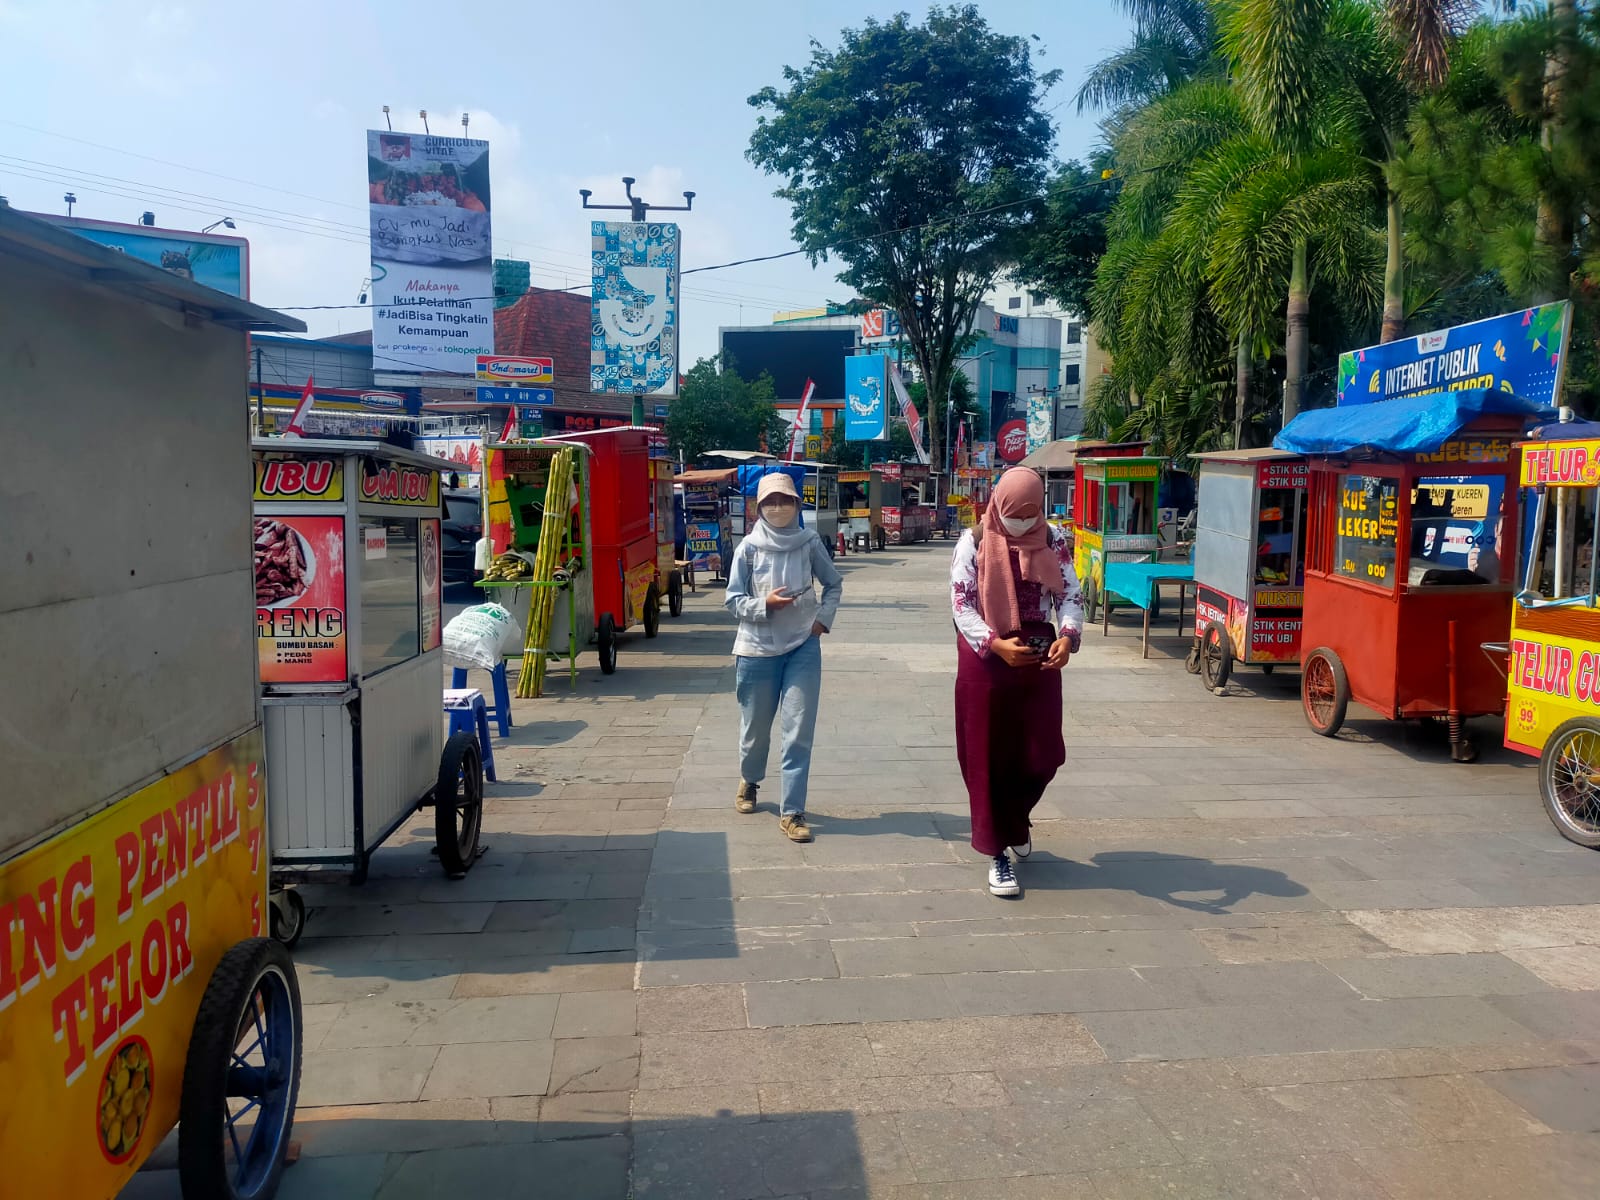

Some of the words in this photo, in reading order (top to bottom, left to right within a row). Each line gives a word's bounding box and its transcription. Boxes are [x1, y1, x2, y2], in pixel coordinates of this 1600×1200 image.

[405, 279, 460, 294] Makanya
[393, 295, 416, 306] Ikut
[419, 297, 472, 309] Pelatihan
[377, 309, 433, 321] #JadiBisa
[436, 312, 488, 325] Tingkatin
[399, 325, 469, 338] Kemampuan
[444, 345, 490, 355] tokopedia
[491, 362, 538, 374] Indomaret
[1385, 357, 1435, 395] INTERNET
[1437, 343, 1482, 382] PUBLIK
[565, 416, 595, 428] POS
[1107, 466, 1128, 477] TELUR
[1130, 465, 1157, 477] GULUNG
[1270, 465, 1289, 474] STIK
[1293, 465, 1310, 474] KEN
[1526, 448, 1587, 482] TELUR
[262, 459, 333, 495] IBU
[1269, 477, 1288, 486] STIK
[1292, 477, 1307, 486] UBI
[401, 470, 429, 501] IBU
[1343, 489, 1367, 511] KUE
[1457, 489, 1483, 499] KUEREN
[1338, 517, 1378, 539] LEKER
[691, 540, 717, 552] LEKER
[1257, 591, 1303, 606] MUSTI
[256, 608, 342, 637] RENG
[1254, 621, 1274, 630] STIK
[1277, 621, 1302, 630] KENT
[276, 641, 306, 649] BUMBU
[307, 641, 334, 649] BASAH
[1253, 634, 1274, 643] STIK
[1277, 634, 1292, 643] UBI
[1512, 639, 1573, 697] TELUR
[1575, 651, 1600, 705] GU
[1520, 708, 1533, 722] 99
[0, 854, 95, 1006] ING
[115, 771, 240, 922] PENTIL
[51, 901, 193, 1087] TELOR
